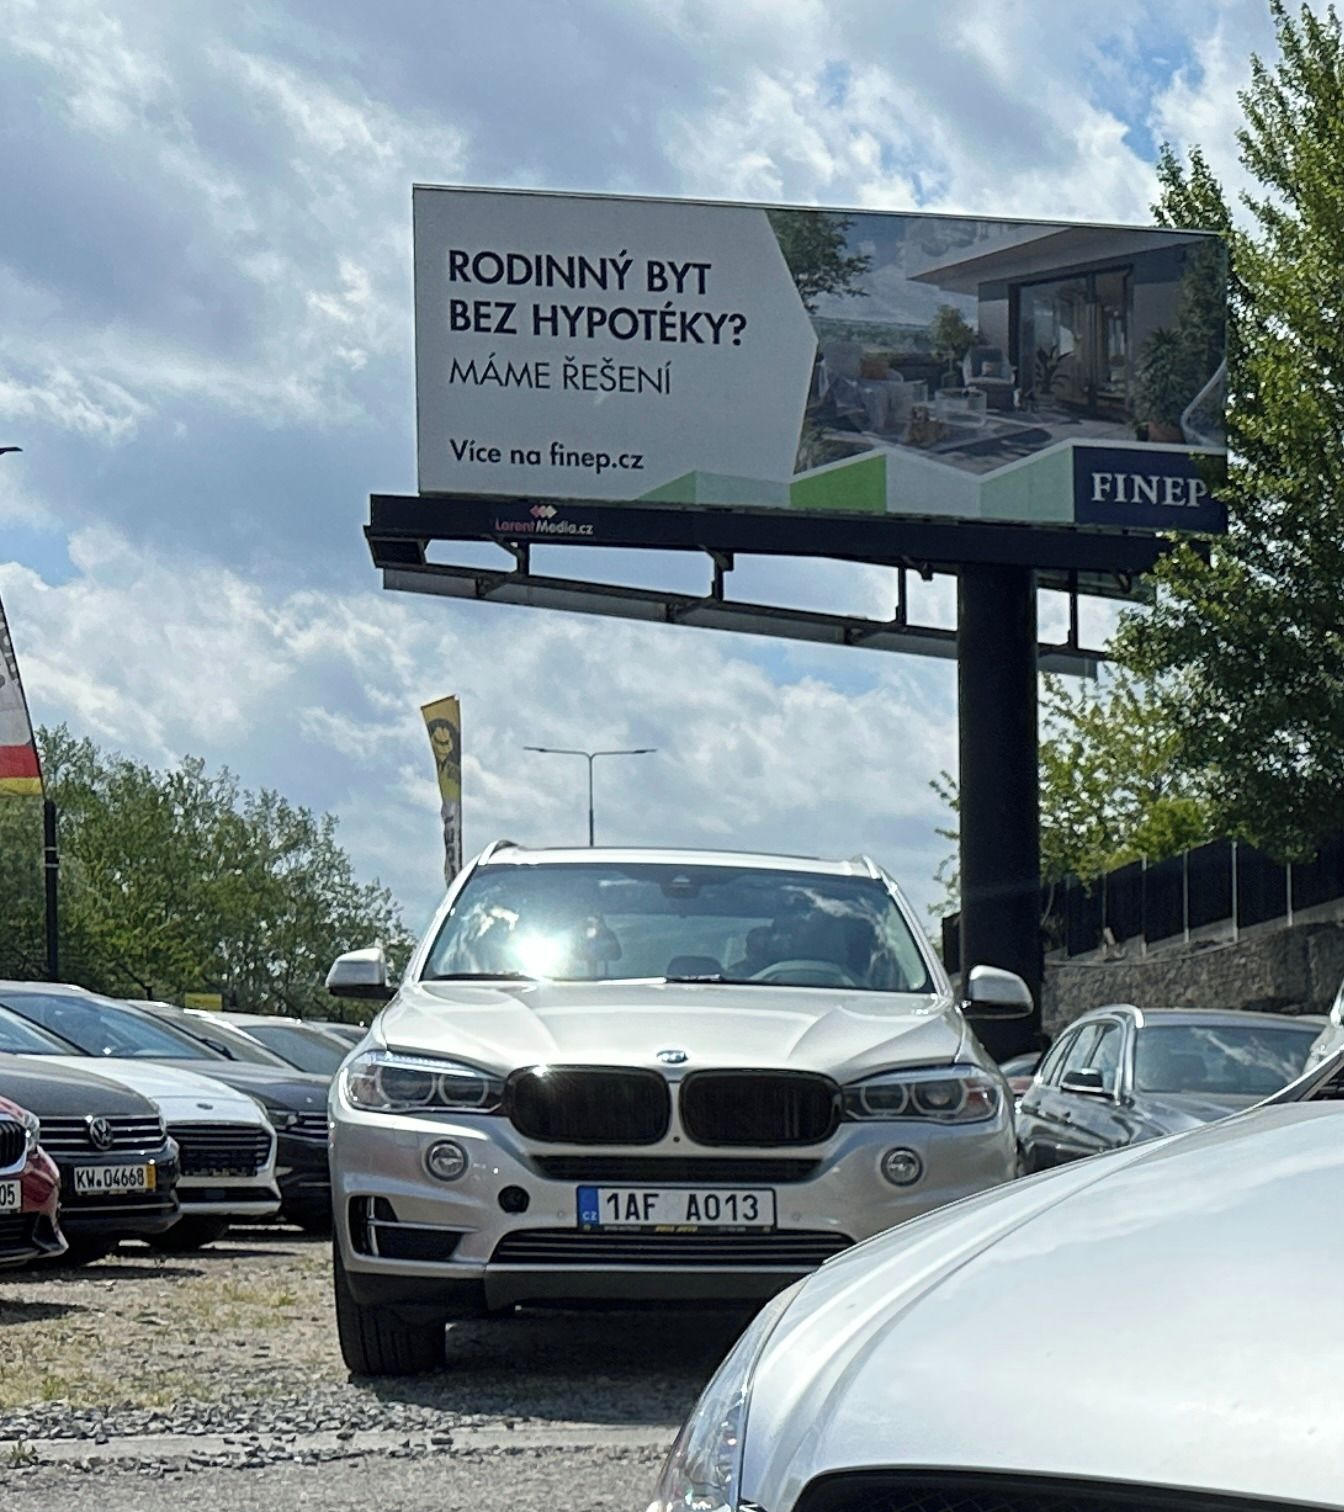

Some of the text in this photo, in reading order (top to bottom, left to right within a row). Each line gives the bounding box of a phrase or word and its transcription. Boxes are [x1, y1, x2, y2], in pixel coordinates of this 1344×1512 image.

[449, 249, 712, 295] RODINNÝ BYT
[449, 299, 747, 346] BEZ HYPOTÉKY?
[449, 352, 672, 395] MÁME ŘEŠENÍ
[449, 439, 645, 474] Více na finep.cz
[1091, 471, 1208, 508] FINEP
[582, 1211, 597, 1221] CZ
[607, 1192, 759, 1222] 1AF A013
